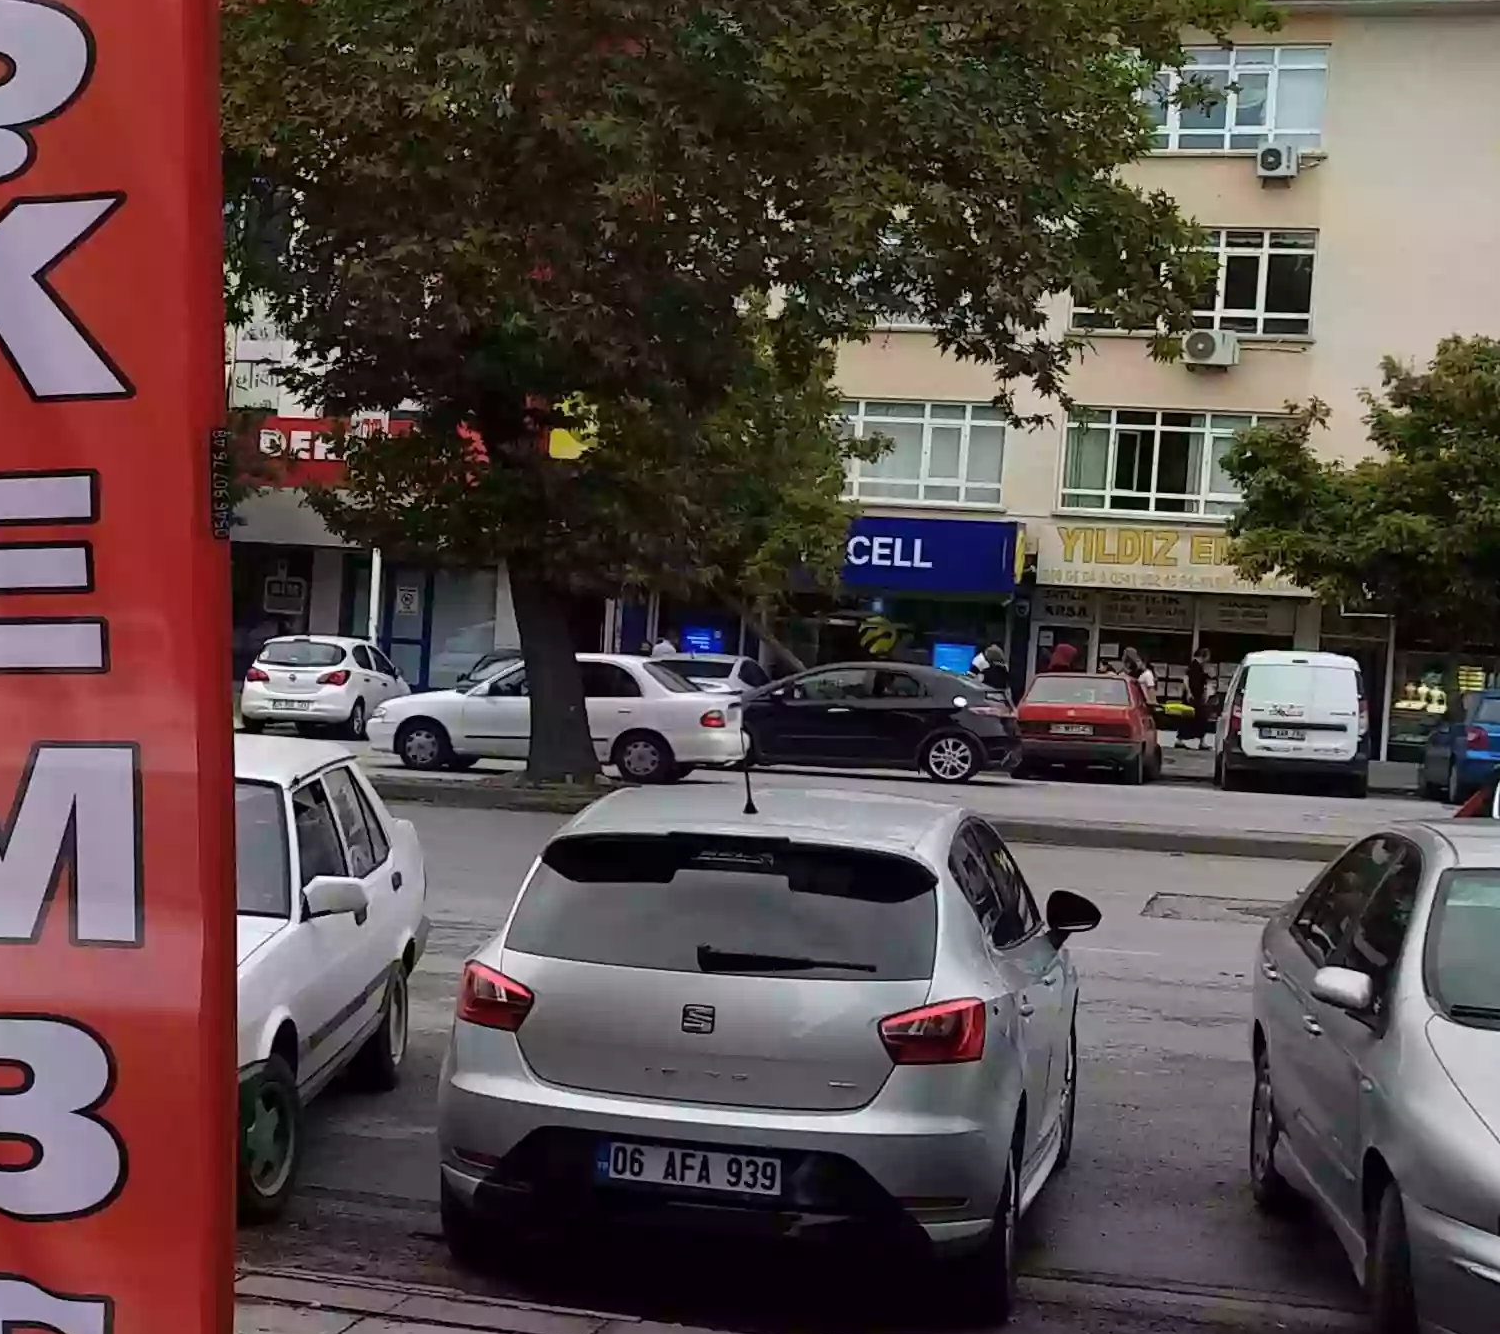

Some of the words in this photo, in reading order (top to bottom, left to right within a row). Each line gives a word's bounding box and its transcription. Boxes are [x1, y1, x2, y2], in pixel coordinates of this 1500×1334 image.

[211, 472, 230, 500] 907
[845, 535, 933, 568] CELL
[1057, 527, 1180, 566] YILDIZ
[613, 1146, 645, 1177] 06
[663, 1150, 711, 1185] AFA
[726, 1157, 777, 1191] 939
